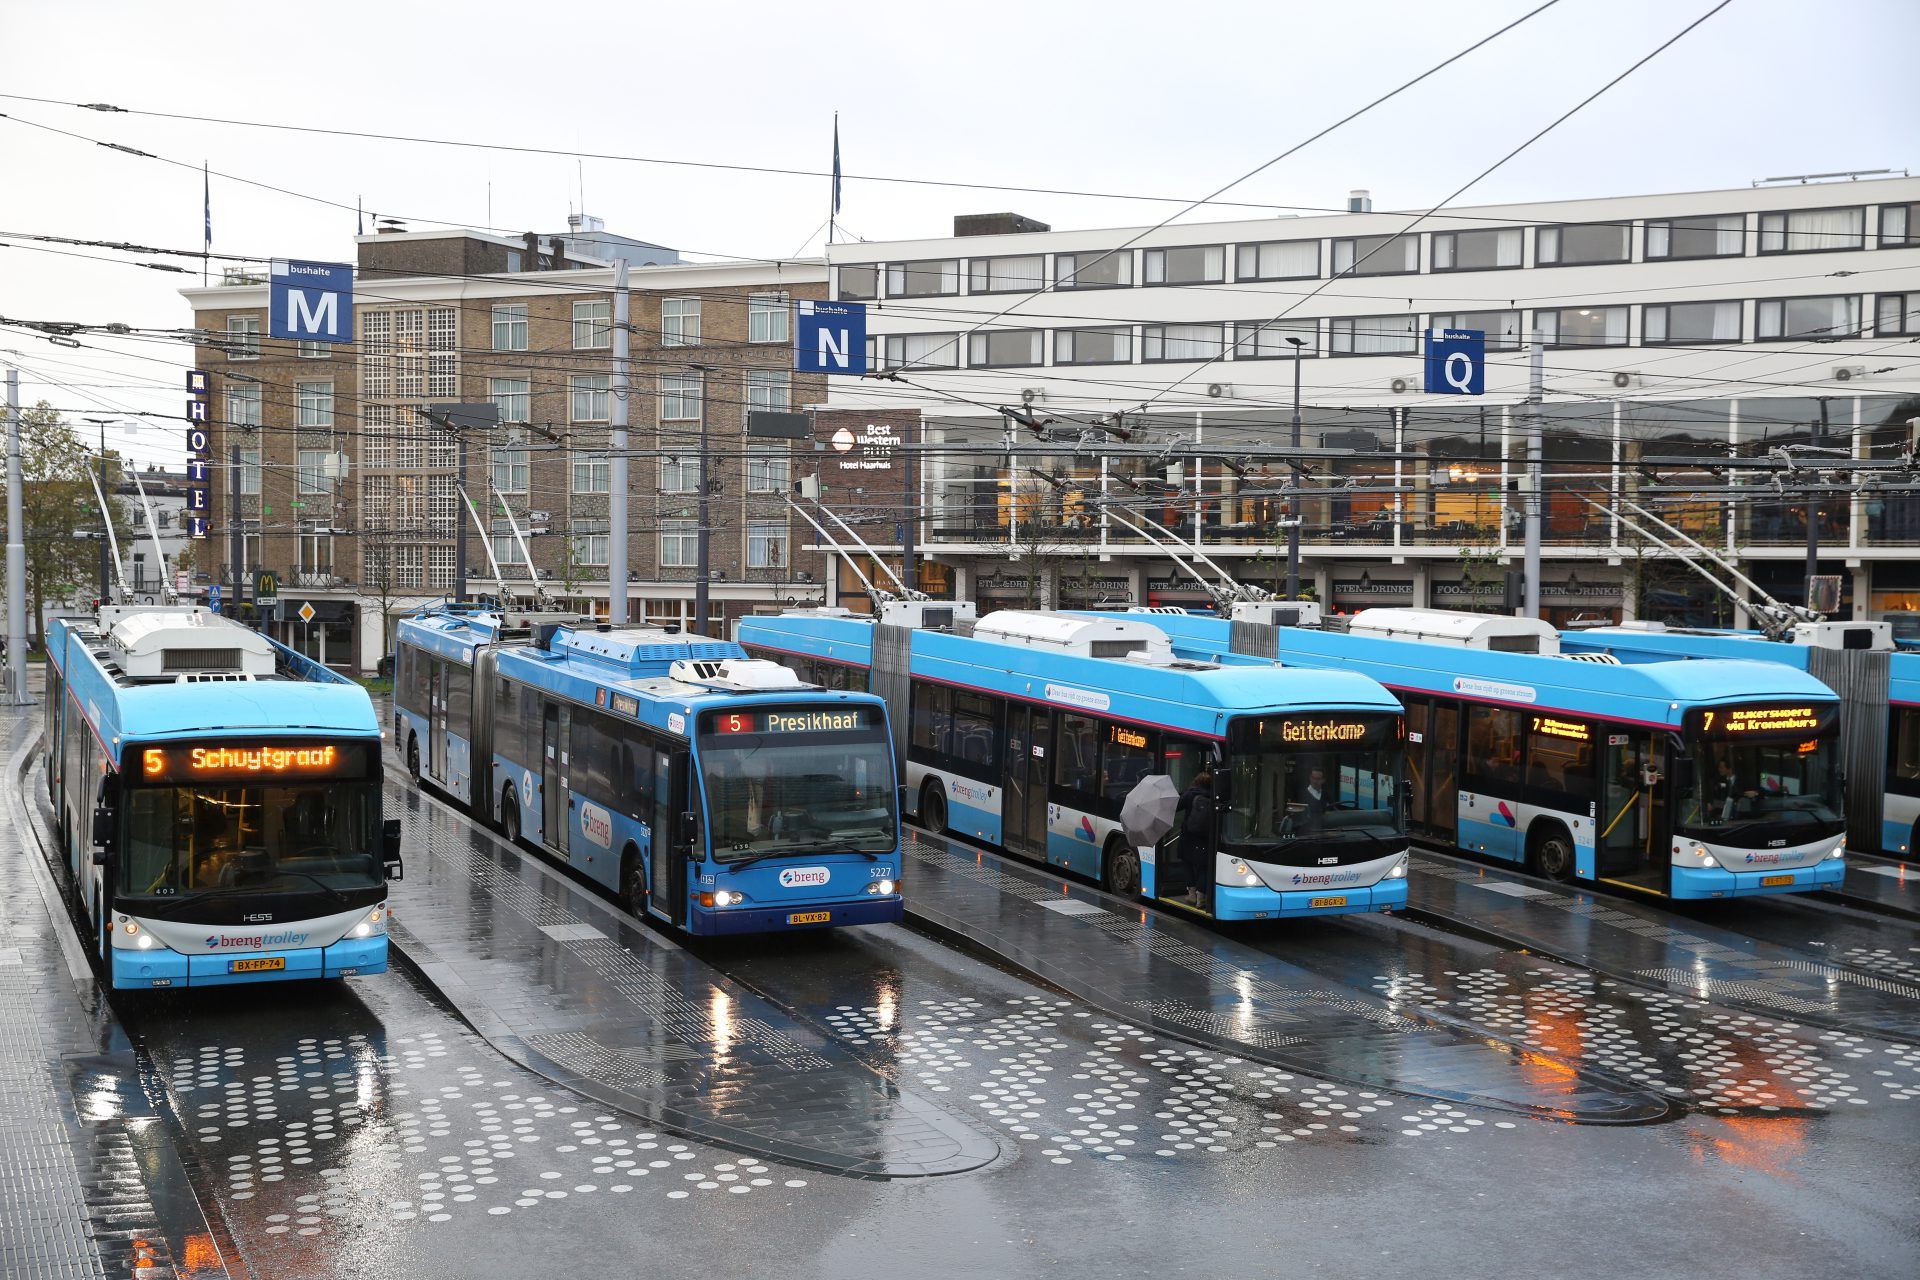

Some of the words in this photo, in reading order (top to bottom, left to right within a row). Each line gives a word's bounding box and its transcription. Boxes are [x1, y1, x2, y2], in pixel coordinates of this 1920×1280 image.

[291, 265, 331, 276] bushalte
[287, 289, 338, 335] M
[815, 305, 848, 315] bushalte
[818, 328, 849, 368] N
[1445, 352, 1473, 394] Q
[866, 424, 892, 436] Best
[857, 435, 900, 446] Western
[191, 402, 206, 537] HOTEL
[840, 461, 859, 470] Hotel
[860, 461, 892, 470] Haarhuis
[730, 715, 742, 732] 5
[768, 711, 858, 732] Presikhaaf
[1533, 717, 1540, 731] 7
[1703, 712, 1714, 731] 7
[1747, 718, 1817, 730] Kronenburg
[1283, 720, 1366, 741] Geitenkamp
[145, 749, 163, 773] 5
[192, 746, 335, 770] Schuytgraaf
[589, 808, 609, 846] breng
[1317, 857, 1338, 865] HESS
[794, 870, 826, 884] breng
[870, 867, 892, 878] 5227
[1302, 870, 1362, 886] brengtrolley
[243, 913, 273, 922] HESS
[793, 912, 828, 924] BL-VX-82
[220, 931, 310, 949] brengtrolley
[238, 959, 281, 970] BX-FP-74
